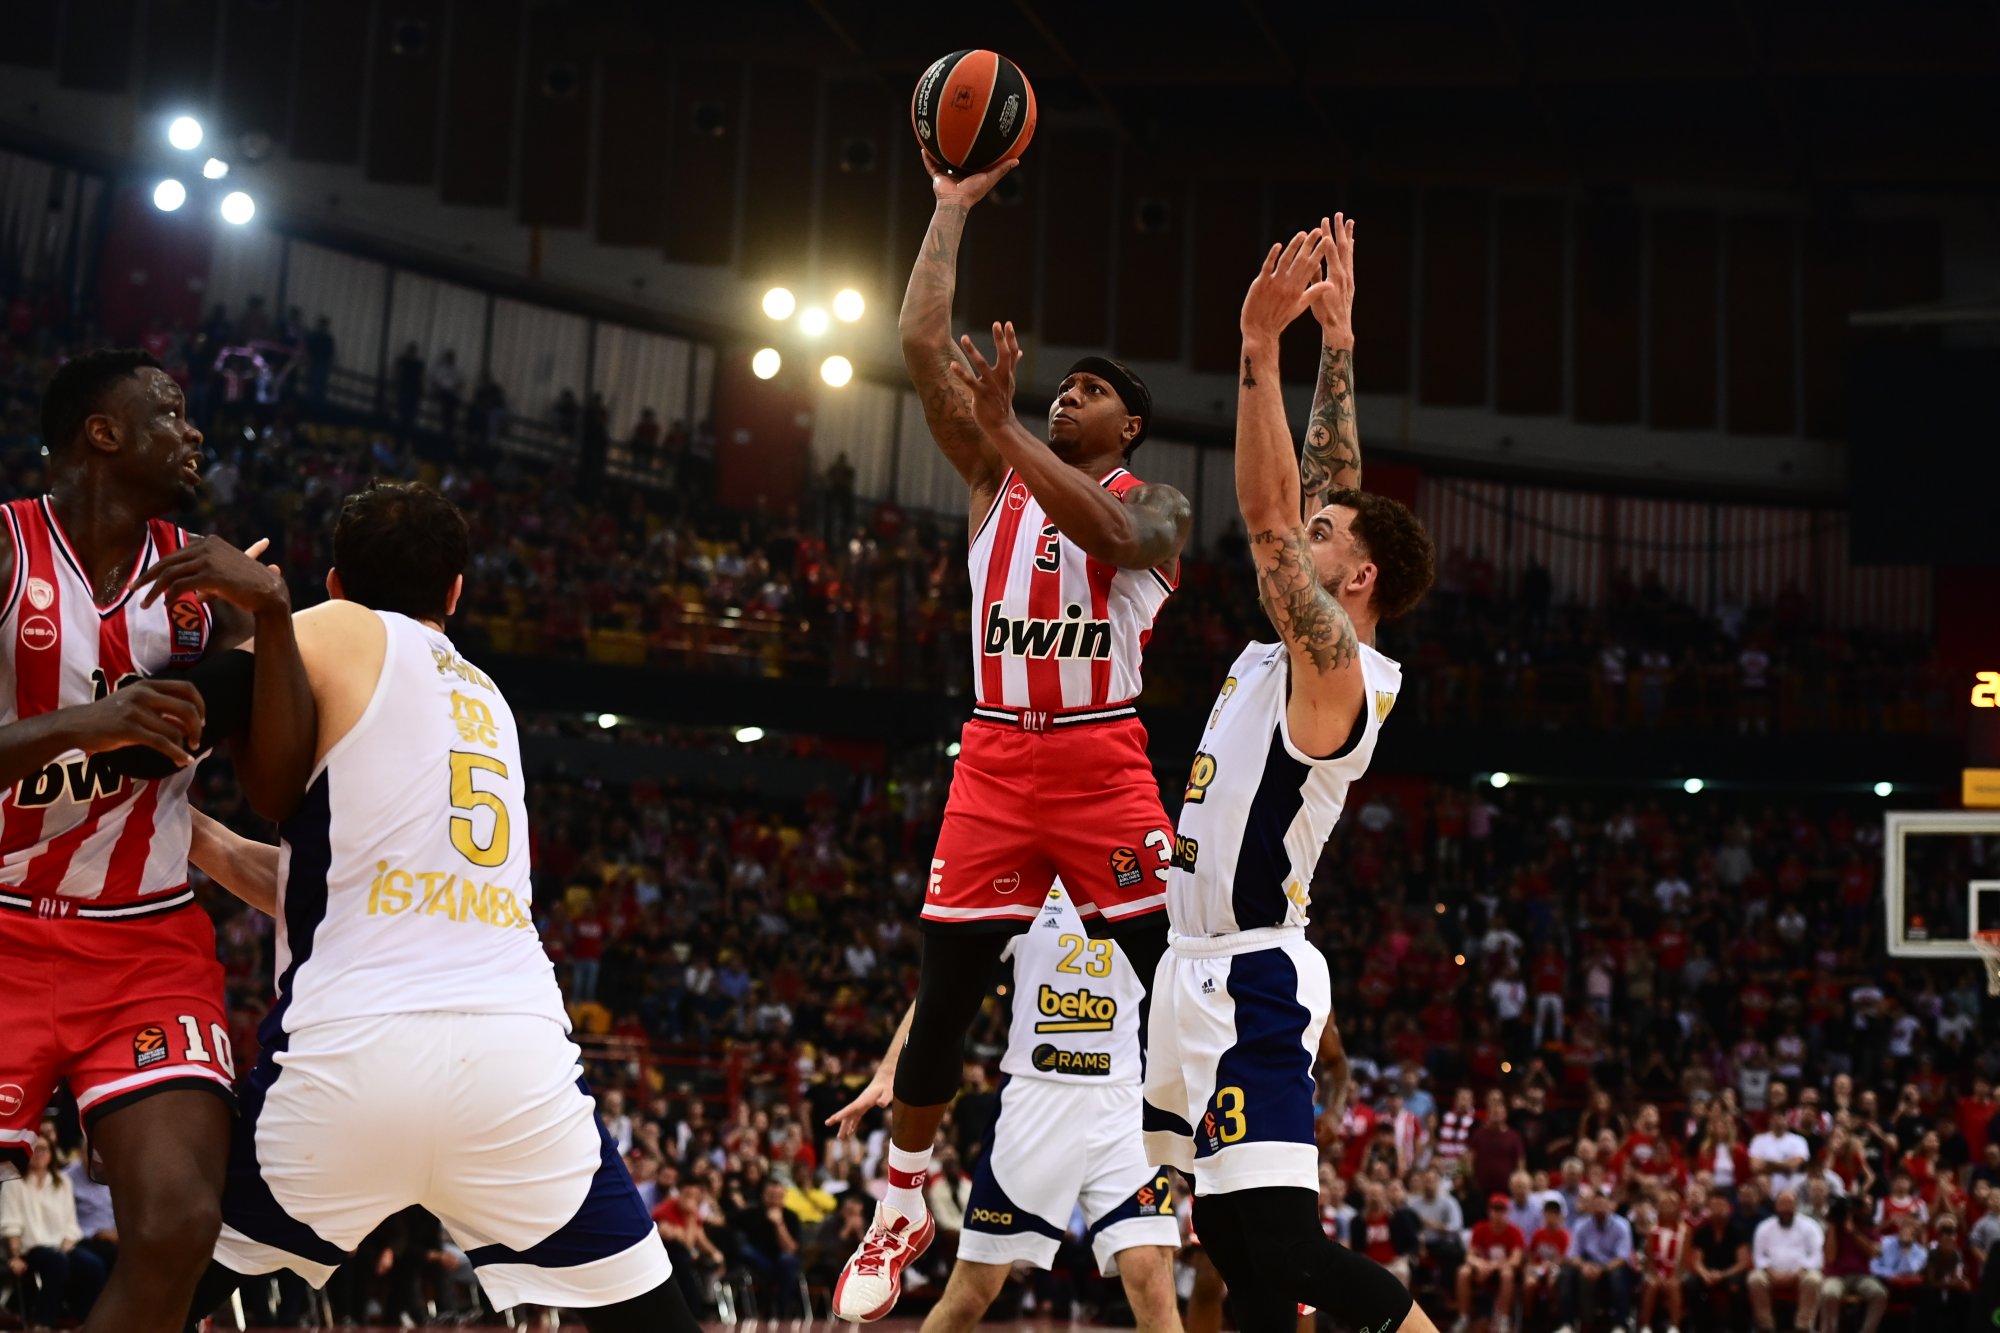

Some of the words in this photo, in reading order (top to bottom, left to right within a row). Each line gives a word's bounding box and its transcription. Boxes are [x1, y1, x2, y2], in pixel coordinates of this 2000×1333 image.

[1034, 524, 1060, 573] 3
[985, 601, 1112, 660] bwin
[1970, 671, 2000, 708] 2
[449, 749, 511, 867] 5
[1144, 829, 1173, 882] 3
[1056, 933, 1114, 978] 23
[1040, 986, 1116, 1021] beko
[178, 1015, 236, 1080] 10
[1058, 1052, 1110, 1070] RAMS
[1216, 1086, 1247, 1143] 3
[970, 1207, 1012, 1225] poca
